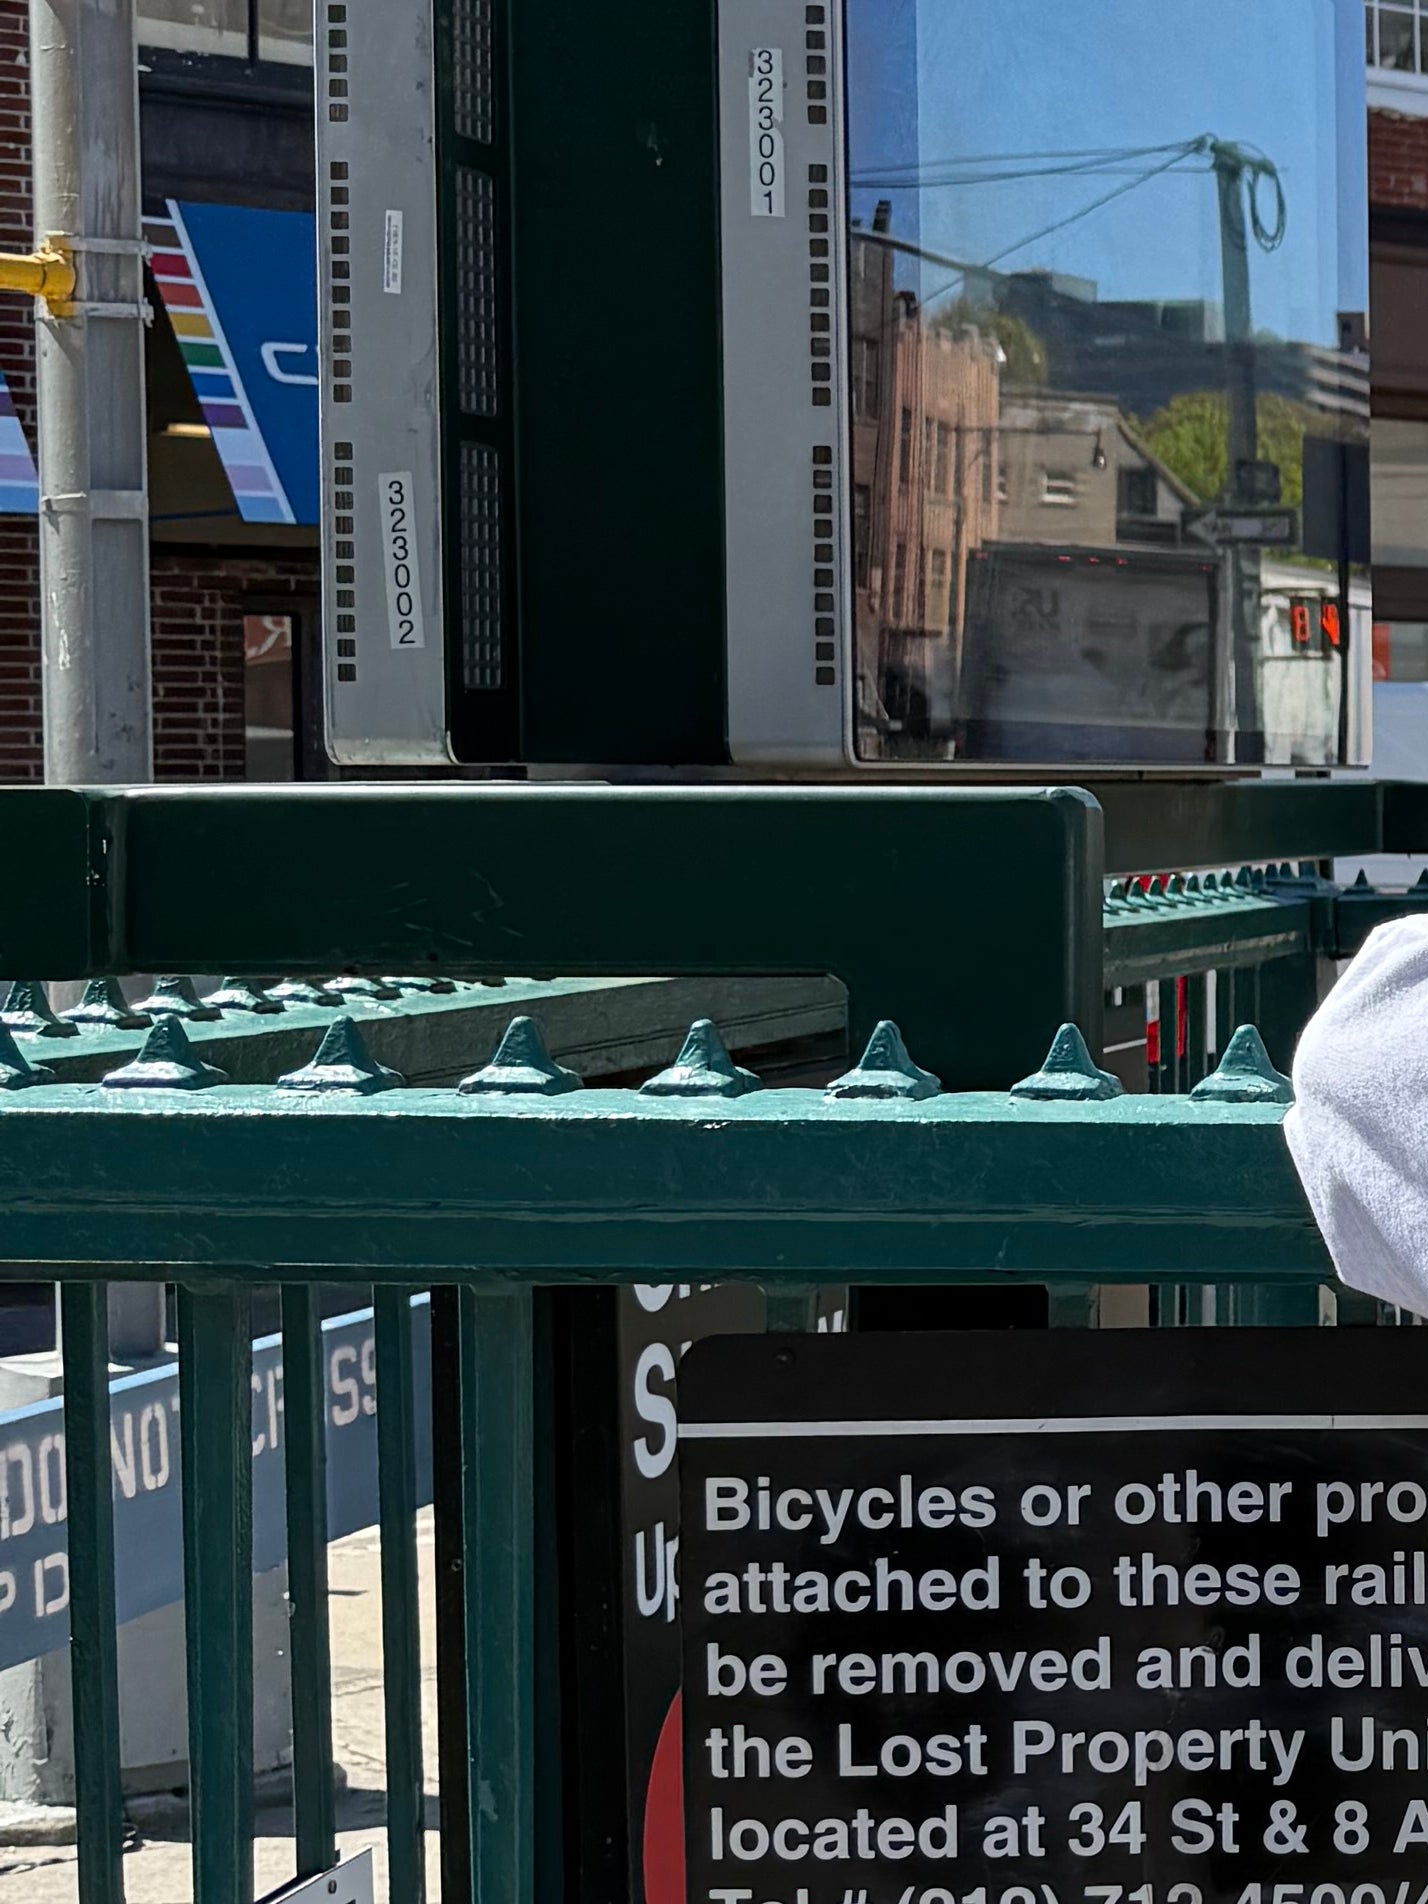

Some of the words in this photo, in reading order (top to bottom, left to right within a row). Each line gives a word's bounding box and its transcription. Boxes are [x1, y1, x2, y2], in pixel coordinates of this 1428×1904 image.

[756, 50, 775, 214] 323001
[388, 481, 415, 644] 323002
[109, 1398, 180, 1498] NO
[705, 1475, 997, 1545] Bicycles
[1021, 1482, 1091, 1527] or
[1113, 1469, 1291, 1524] other
[703, 1556, 1000, 1613] attached
[1023, 1558, 1091, 1610] to
[1112, 1553, 1300, 1606] these
[707, 1643, 787, 1696] be
[812, 1637, 1110, 1694] removed
[1136, 1633, 1260, 1691] and
[705, 1724, 813, 1778] the
[838, 1723, 988, 1777] Lost
[1012, 1720, 1305, 1786] Property
[710, 1805, 958, 1860] located
[982, 1806, 1046, 1858] at
[1067, 1801, 1148, 1857] 34
[1170, 1798, 1239, 1855] St
[1262, 1800, 1310, 1853] &
[1332, 1800, 1369, 1854] 8
